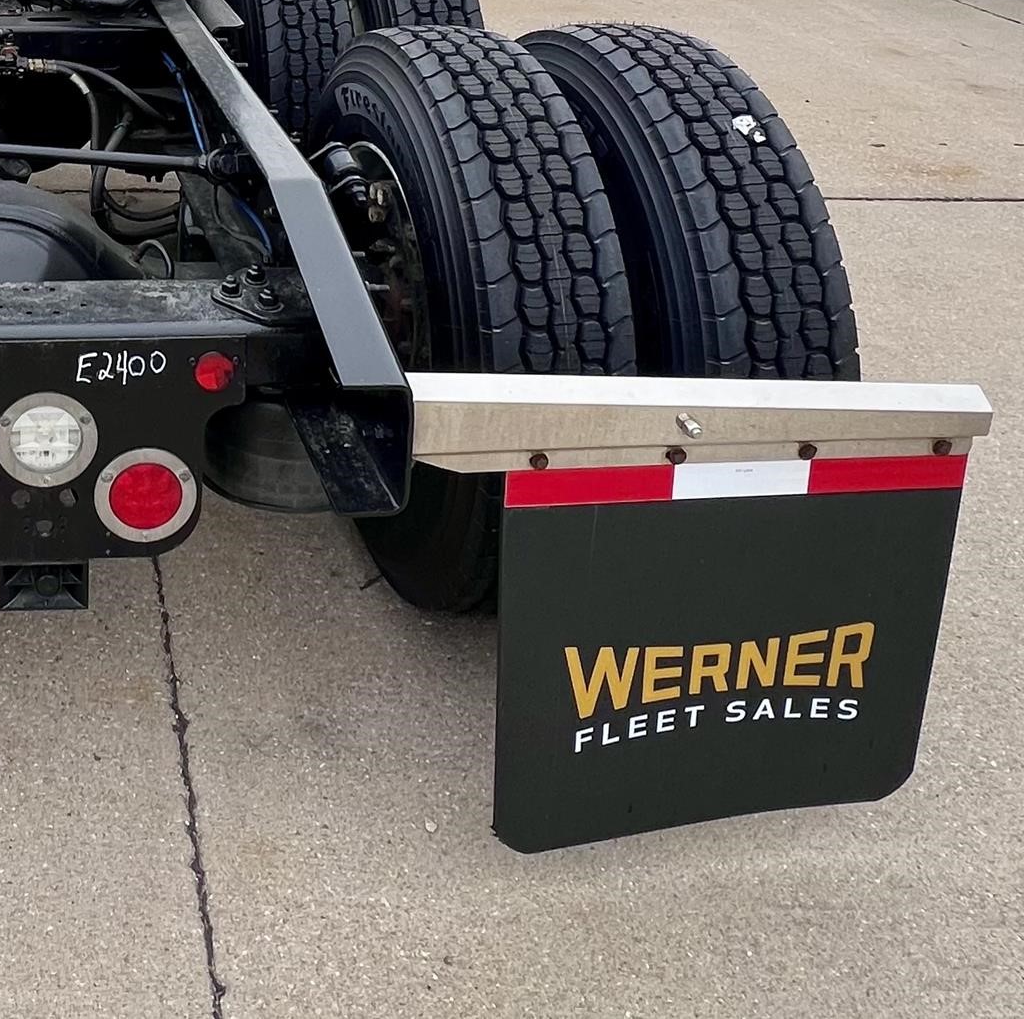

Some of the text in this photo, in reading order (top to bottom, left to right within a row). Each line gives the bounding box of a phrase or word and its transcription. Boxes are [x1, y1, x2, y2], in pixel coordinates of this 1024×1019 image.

[76, 350, 167, 386] E2400
[564, 621, 875, 720] WERNER
[574, 697, 859, 753] FLEET SALES
